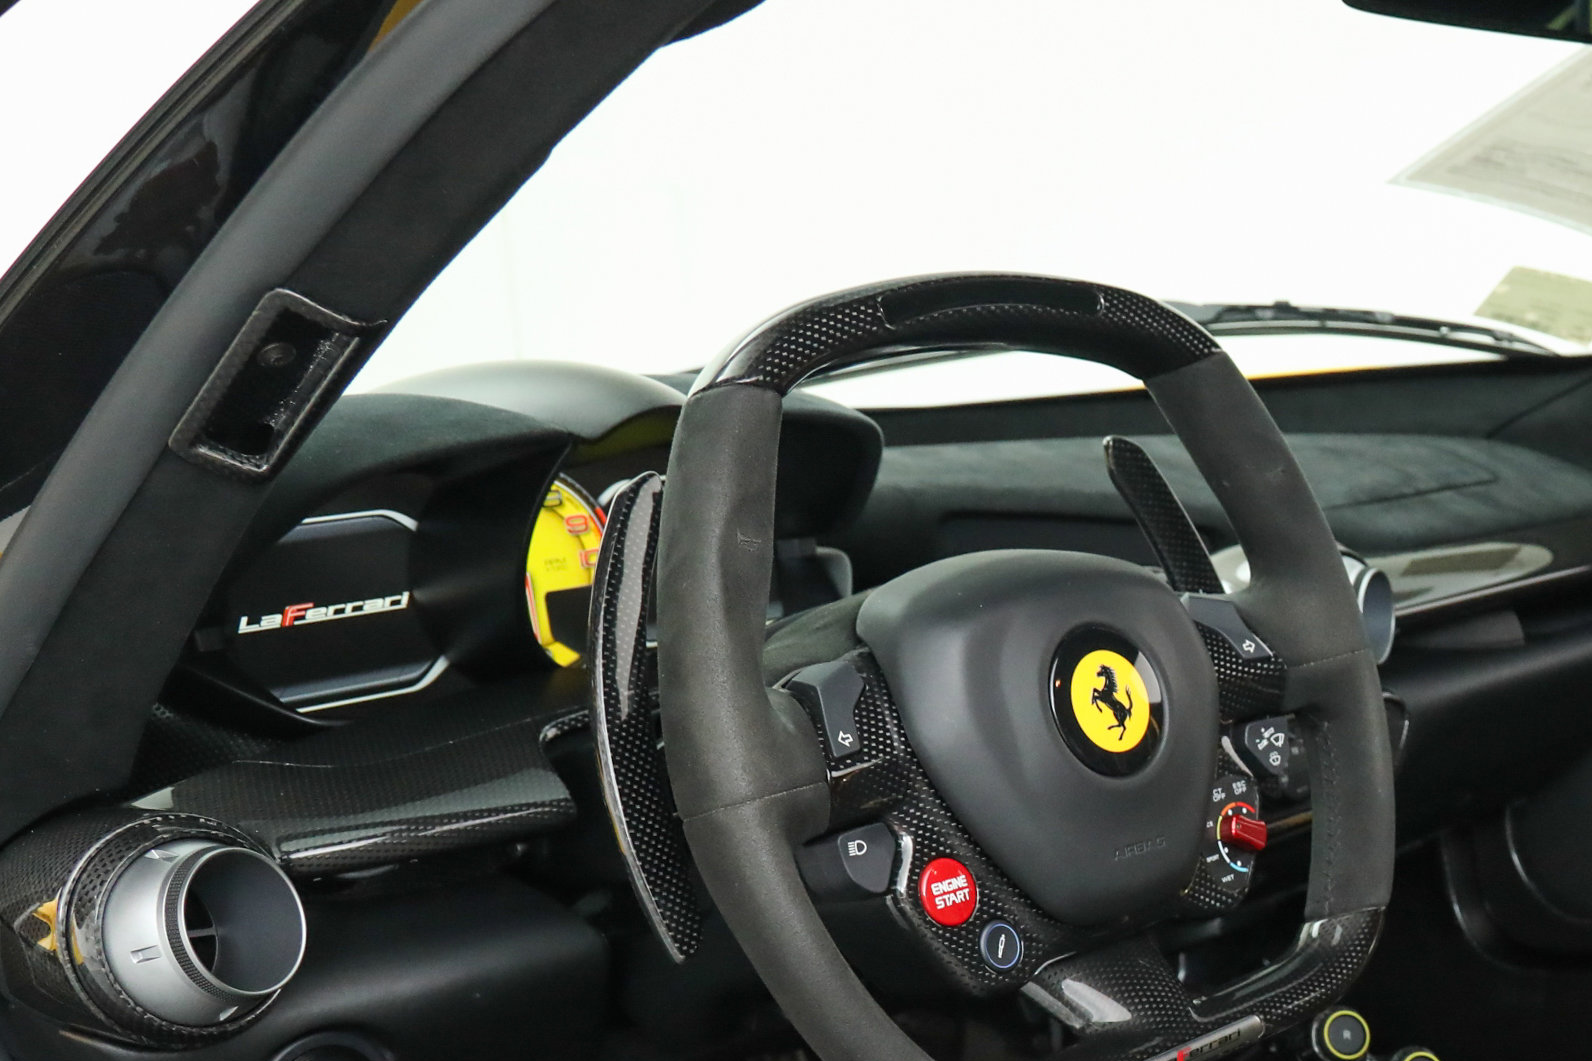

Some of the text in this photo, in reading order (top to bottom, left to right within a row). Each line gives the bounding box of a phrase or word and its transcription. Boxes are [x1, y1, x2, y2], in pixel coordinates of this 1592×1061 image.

[565, 514, 589, 535] 9
[931, 874, 968, 896] ENGINE
[935, 888, 970, 910] START
[1342, 1030, 1351, 1040] R
